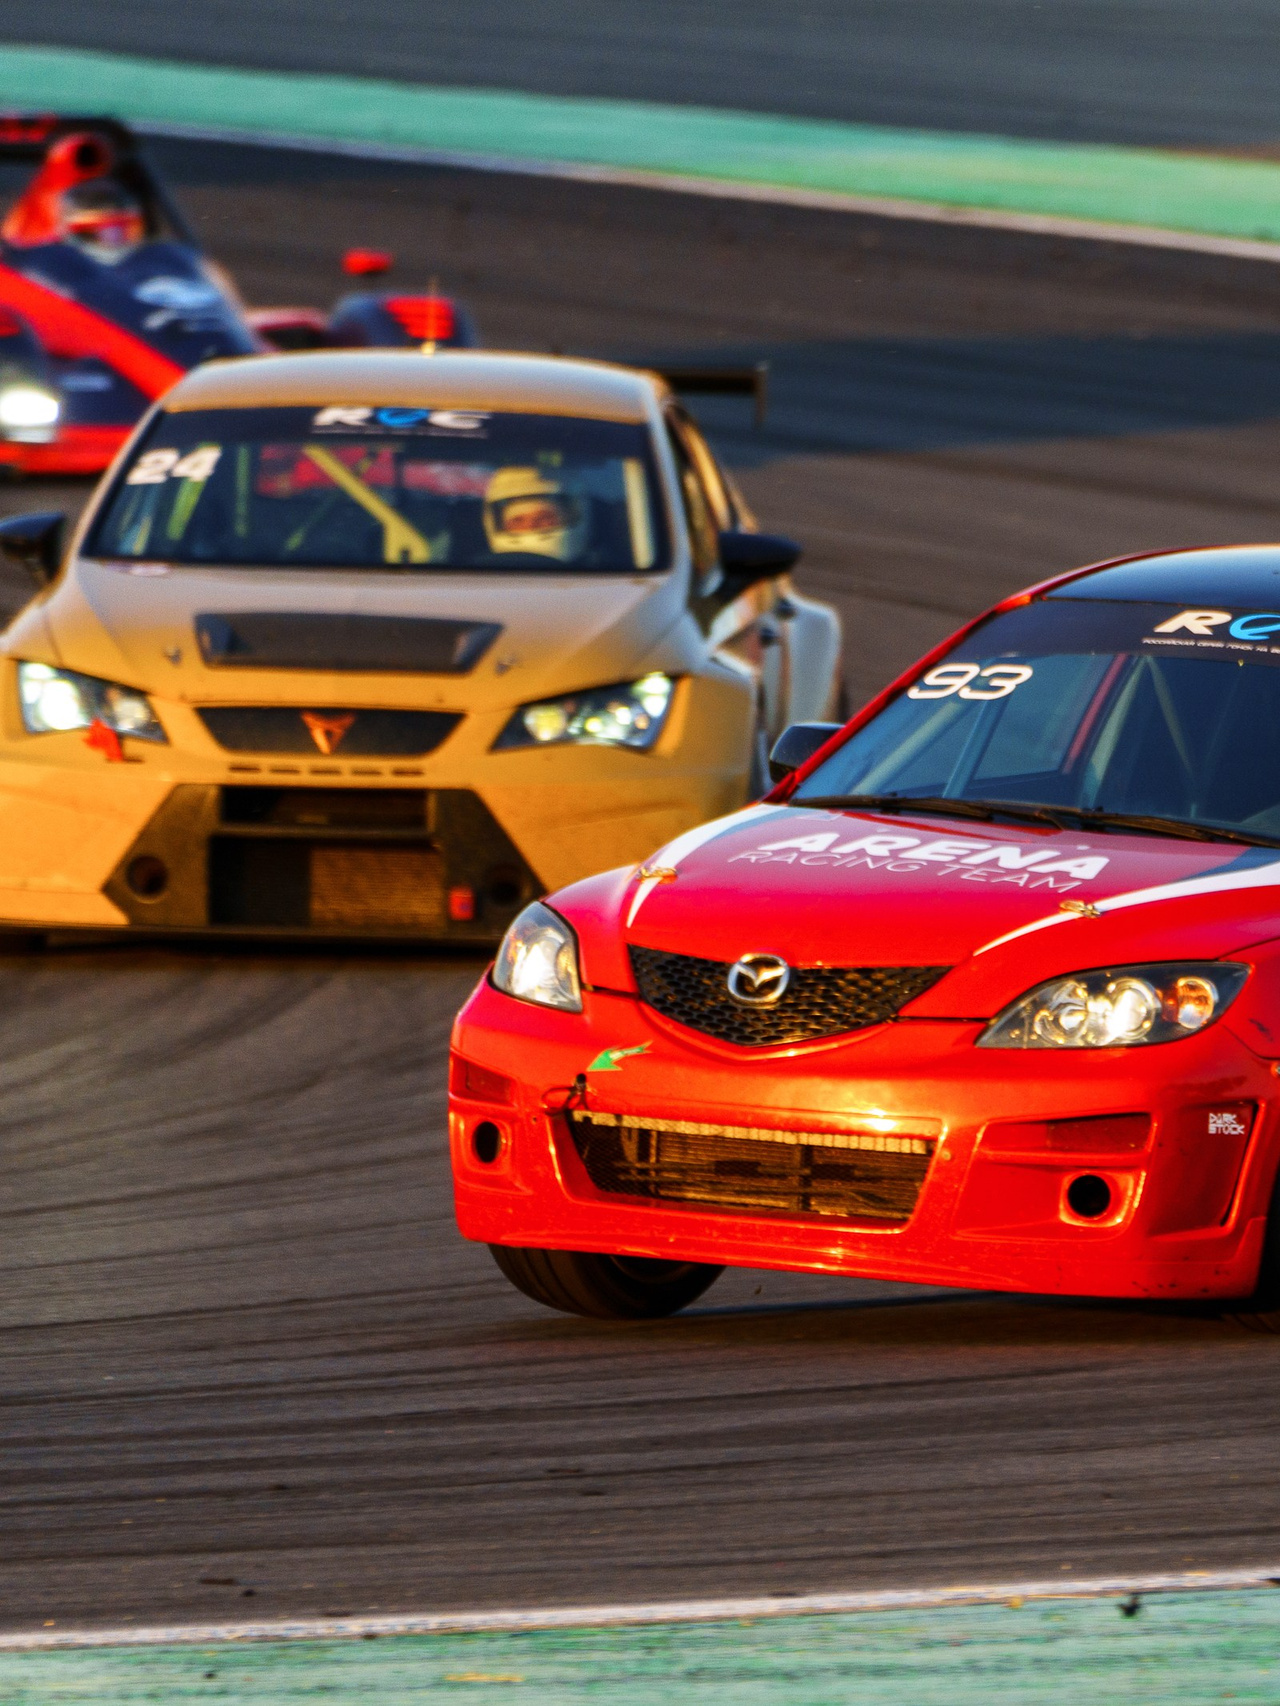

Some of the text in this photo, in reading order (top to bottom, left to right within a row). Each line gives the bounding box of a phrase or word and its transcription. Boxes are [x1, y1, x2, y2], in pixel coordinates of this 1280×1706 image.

[126, 447, 222, 485] 24
[907, 663, 1034, 701] 93
[727, 851, 1083, 893] RACING TEAM
[757, 832, 1110, 880] ARENA
